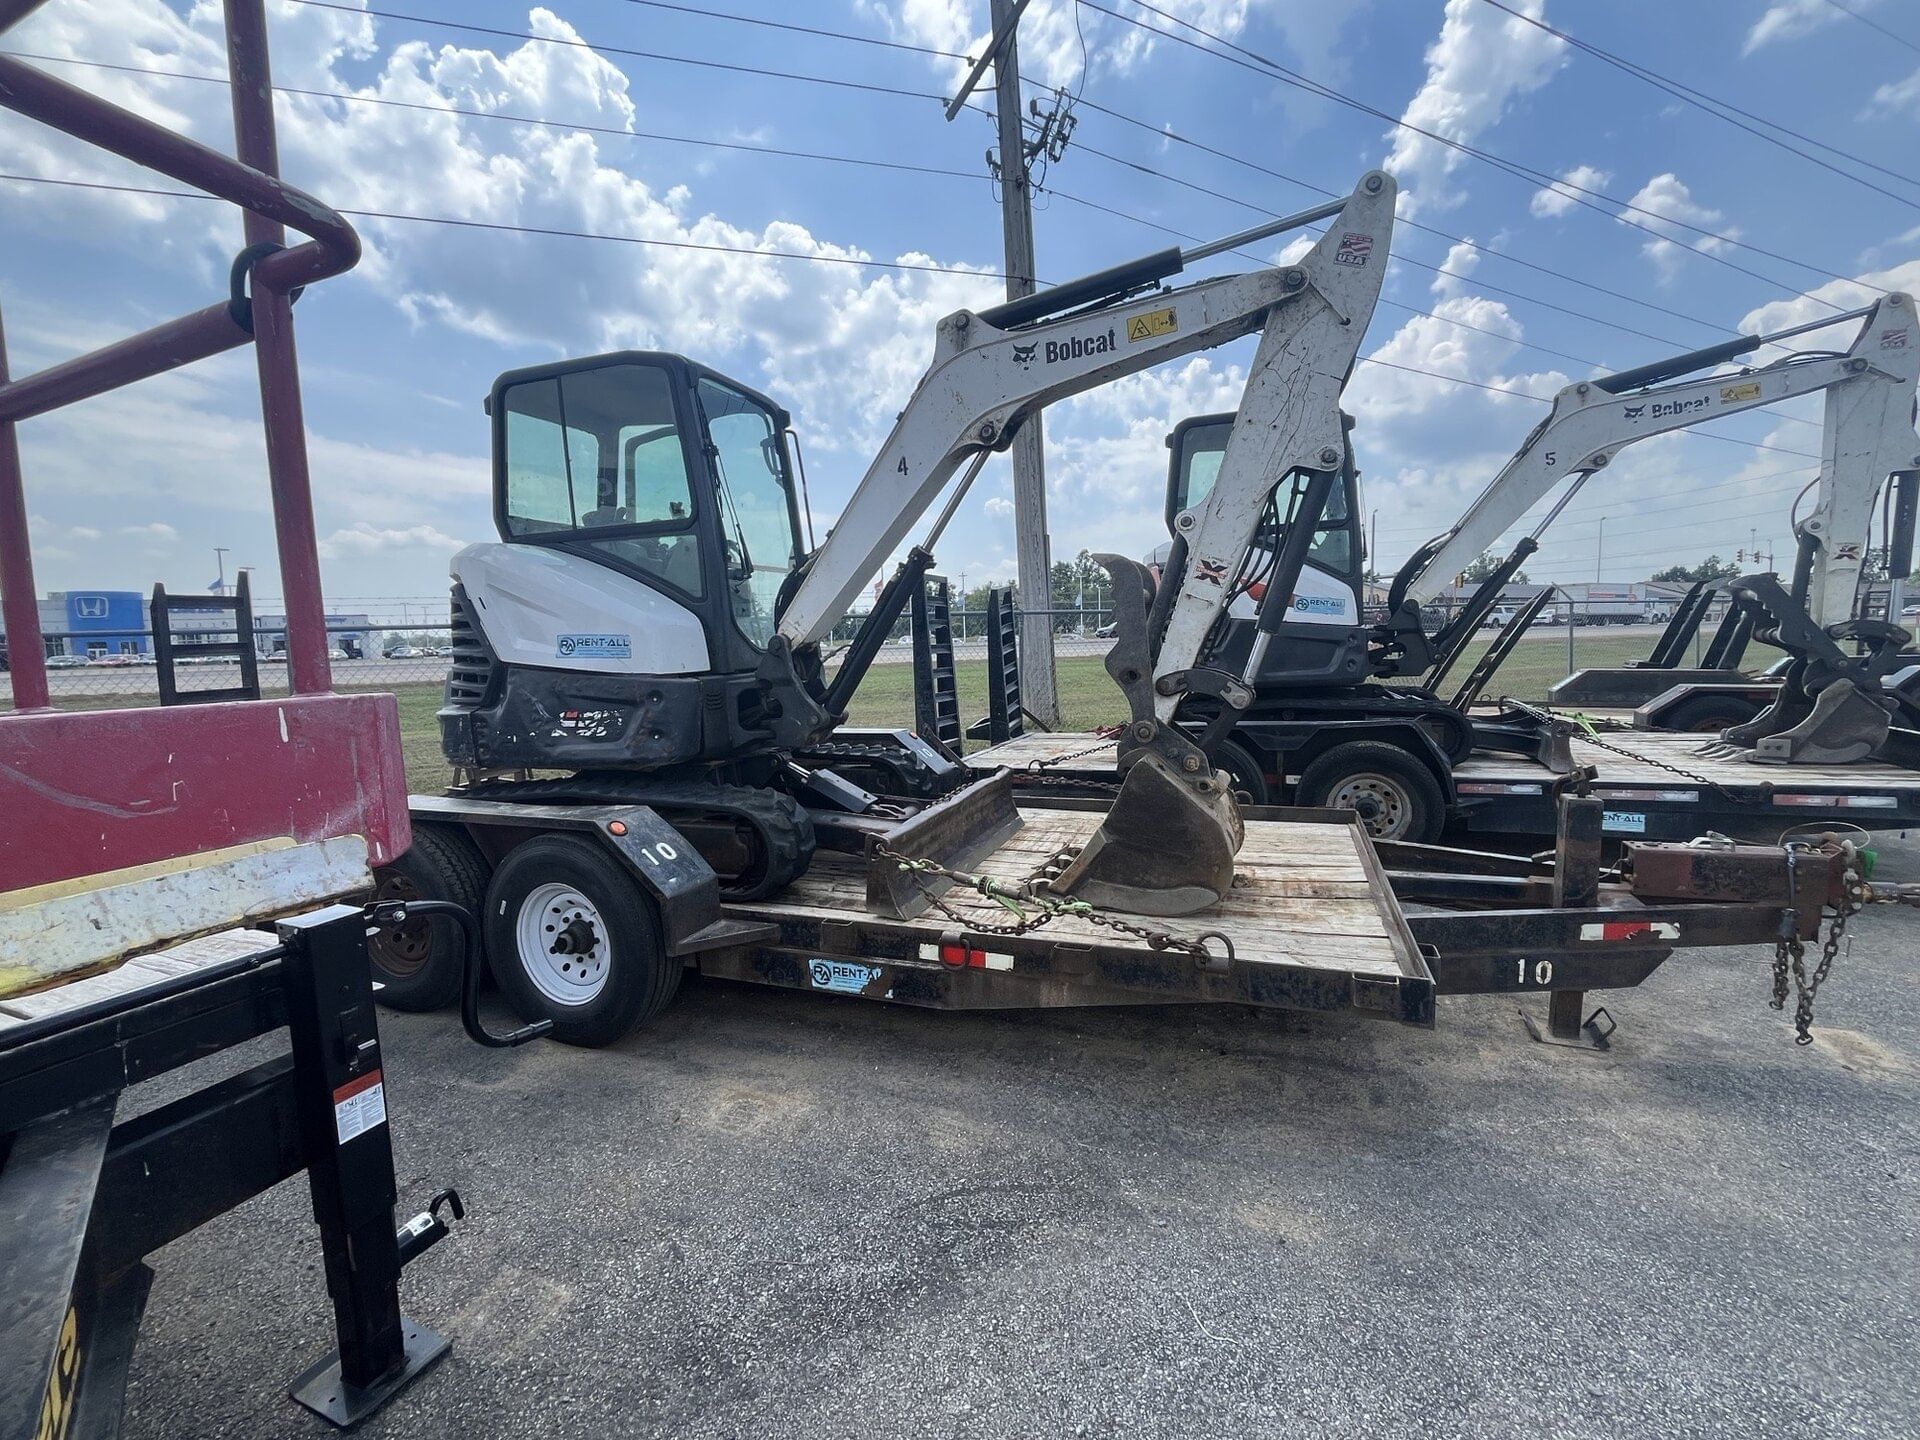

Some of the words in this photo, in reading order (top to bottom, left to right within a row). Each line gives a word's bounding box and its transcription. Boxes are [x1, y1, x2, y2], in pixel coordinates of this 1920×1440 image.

[1337, 253, 1366, 265] USA
[1045, 328, 1117, 364] Bobcat
[897, 455, 909, 476] 4
[1545, 451, 1556, 466] 5
[576, 638, 630, 647] RENT-ALL
[917, 748, 933, 759] 10
[1602, 813, 1643, 823] ENT-ALL
[641, 842, 678, 866] 10
[832, 966, 880, 981] RENT-A
[1517, 958, 1553, 985] 10
